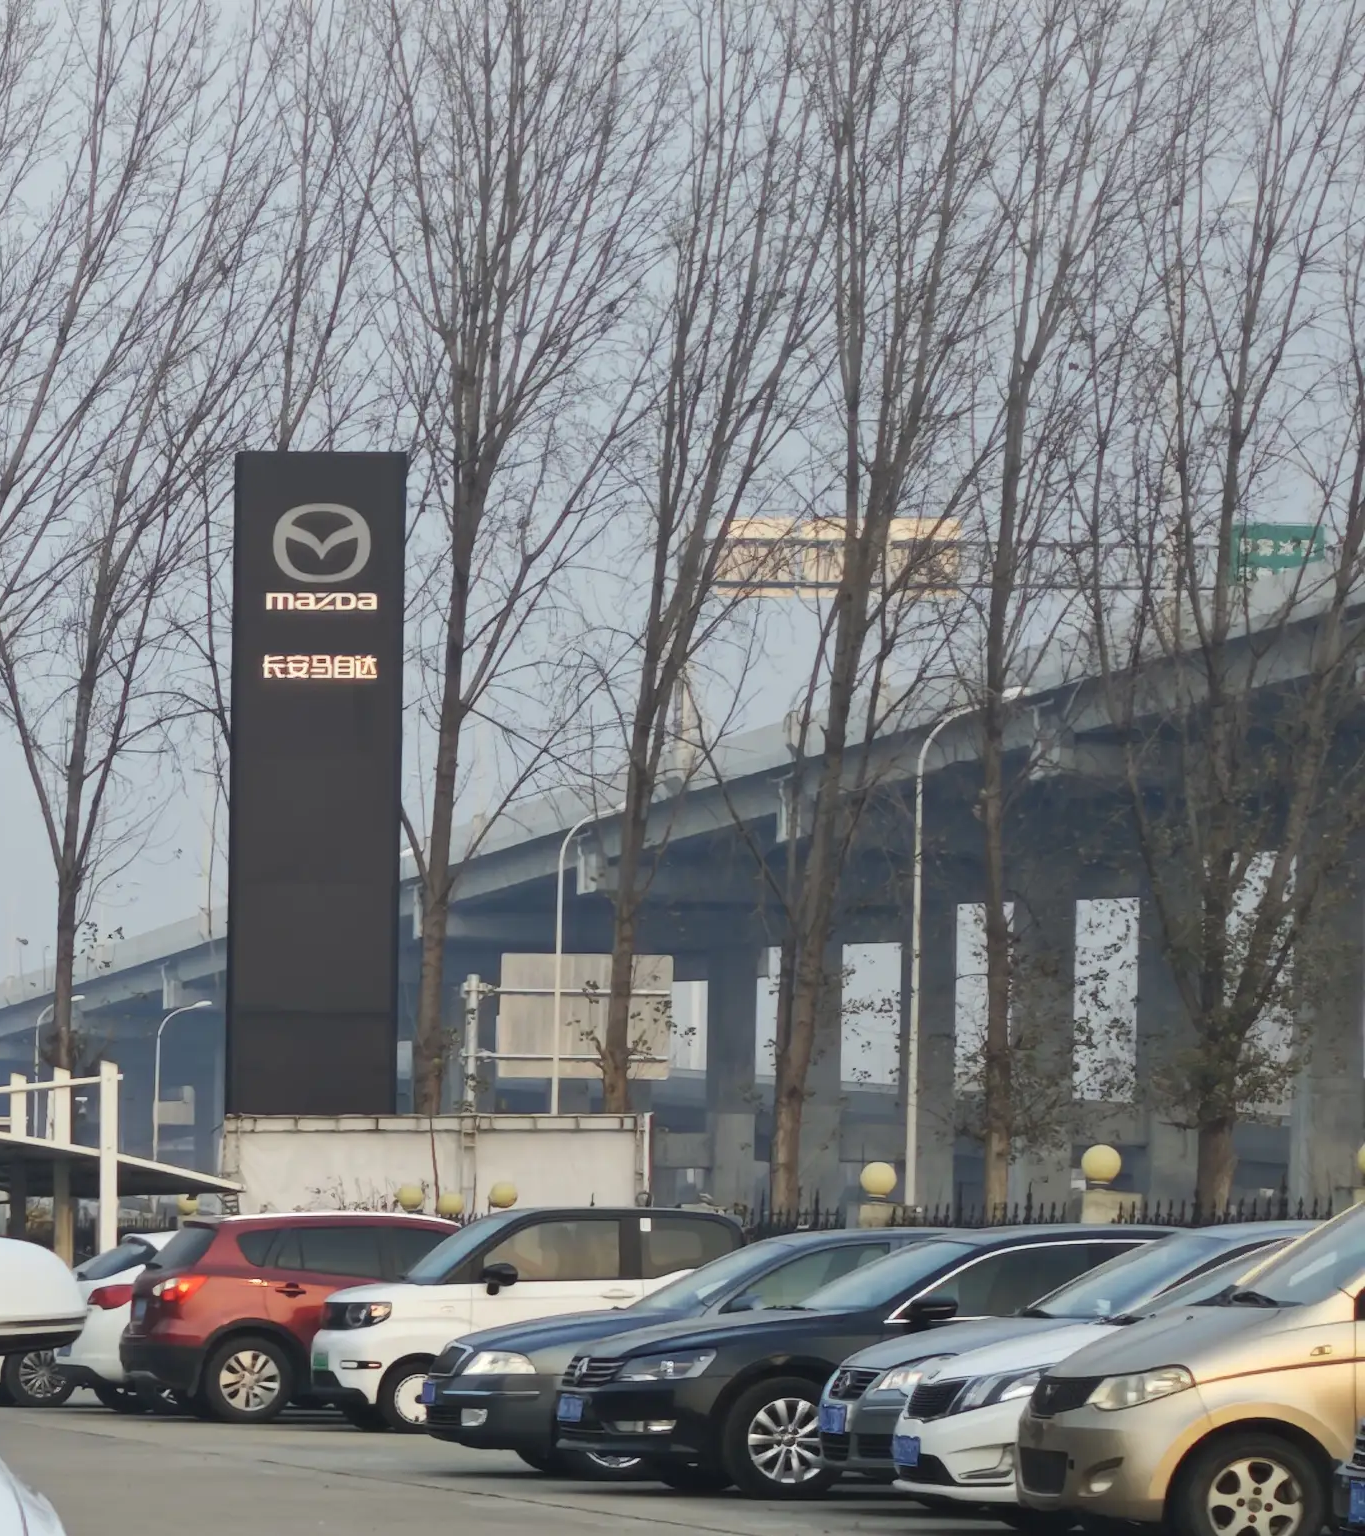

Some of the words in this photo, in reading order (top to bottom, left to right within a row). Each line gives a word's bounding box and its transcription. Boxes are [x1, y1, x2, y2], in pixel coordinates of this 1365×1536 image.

[266, 592, 377, 610] mazda
[263, 654, 377, 679] 长安马自达
